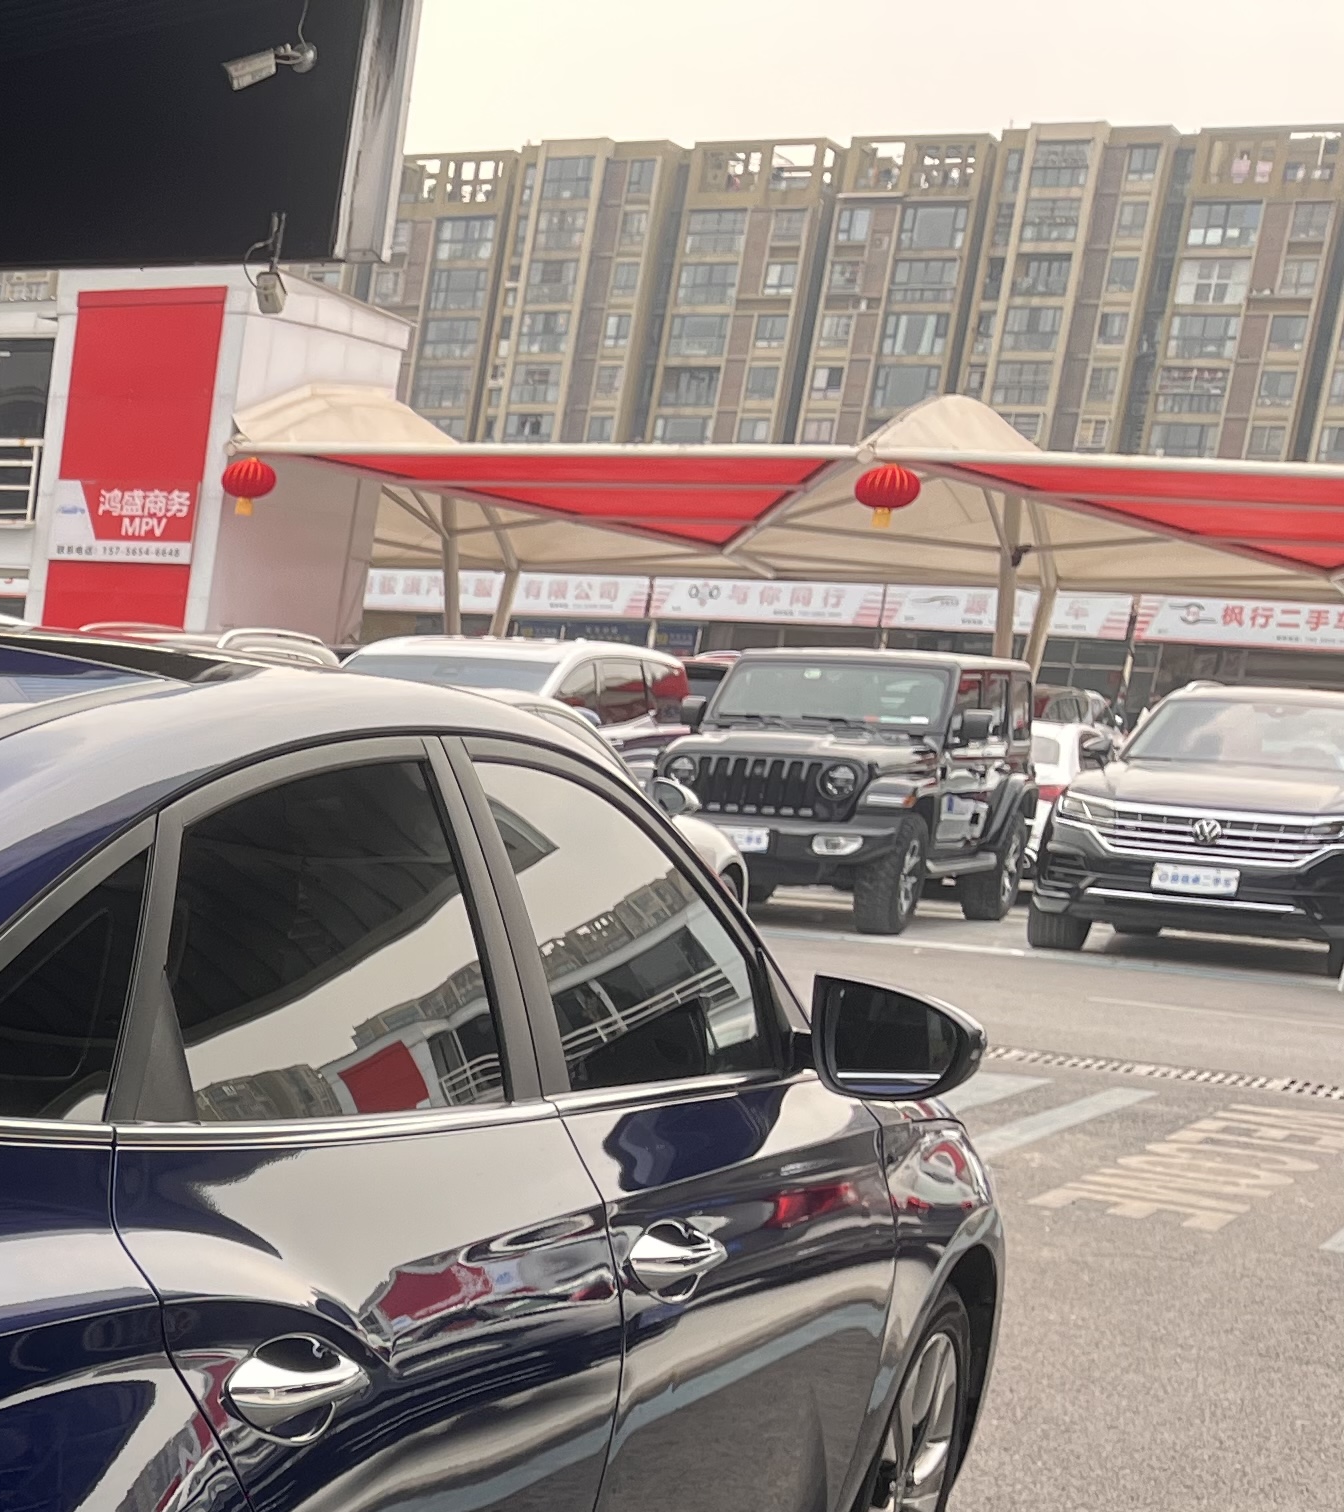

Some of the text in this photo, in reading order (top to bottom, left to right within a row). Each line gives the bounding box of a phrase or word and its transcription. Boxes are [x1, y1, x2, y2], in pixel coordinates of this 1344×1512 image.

[98, 488, 191, 518] 鸿盛商务
[120, 517, 167, 537] MPV
